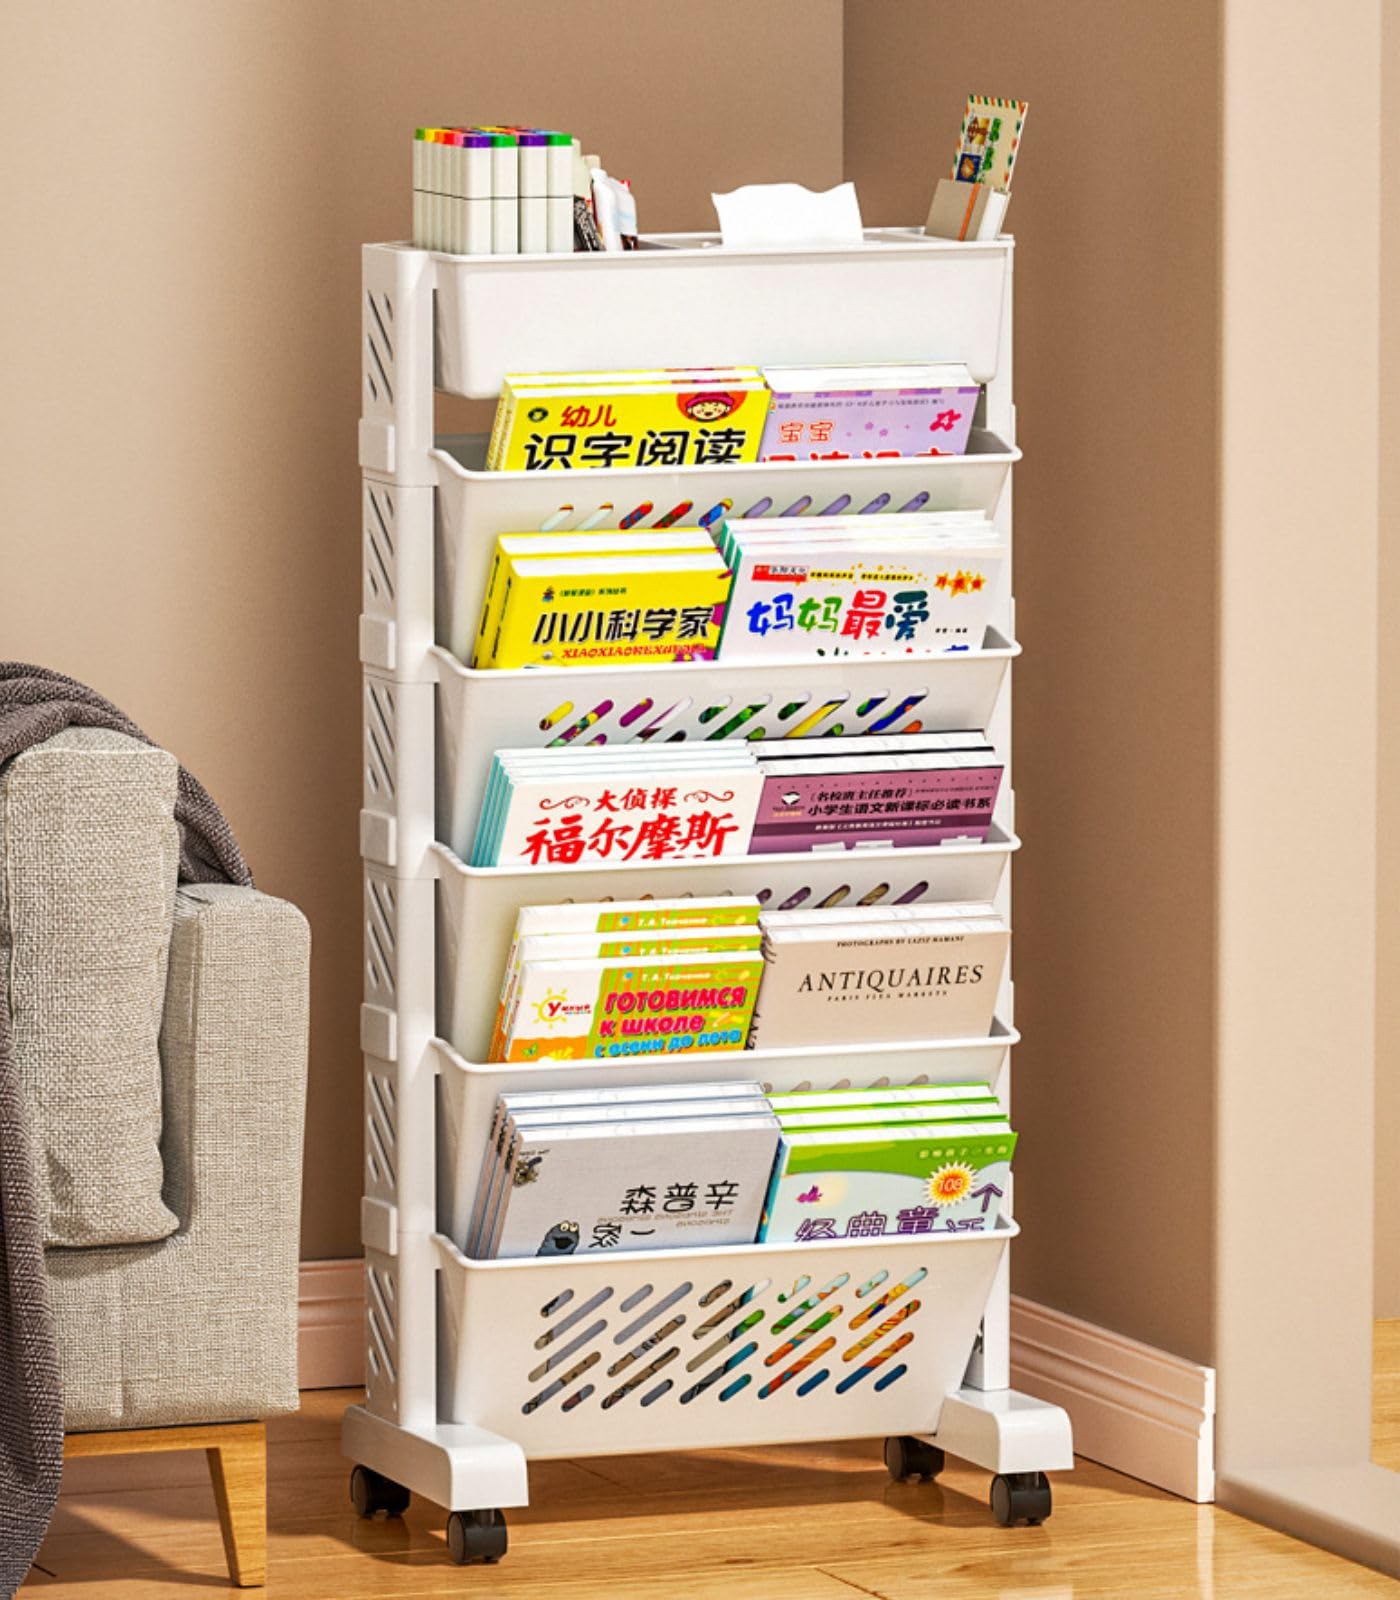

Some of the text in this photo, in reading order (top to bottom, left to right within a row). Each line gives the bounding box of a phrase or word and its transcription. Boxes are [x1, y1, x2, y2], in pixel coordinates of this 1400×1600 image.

[560, 404, 617, 427] 幼儿
[780, 421, 834, 443] 宝宝
[524, 428, 746, 470] 识字阅读
[532, 606, 715, 644] 小小科学家
[746, 590, 930, 641] 妈妈最爱
[593, 787, 678, 812] 大侦探
[520, 810, 739, 865] 福尔摩斯
[797, 964, 984, 993] ANTIQUAIRES
[603, 985, 747, 1014] ГОТОВИМСЯ
[620, 1014, 706, 1037] школе
[609, 1036, 664, 1058] осени
[666, 1035, 694, 1054] до
[698, 1029, 742, 1046] лета
[970, 1183, 1004, 1212] 个
